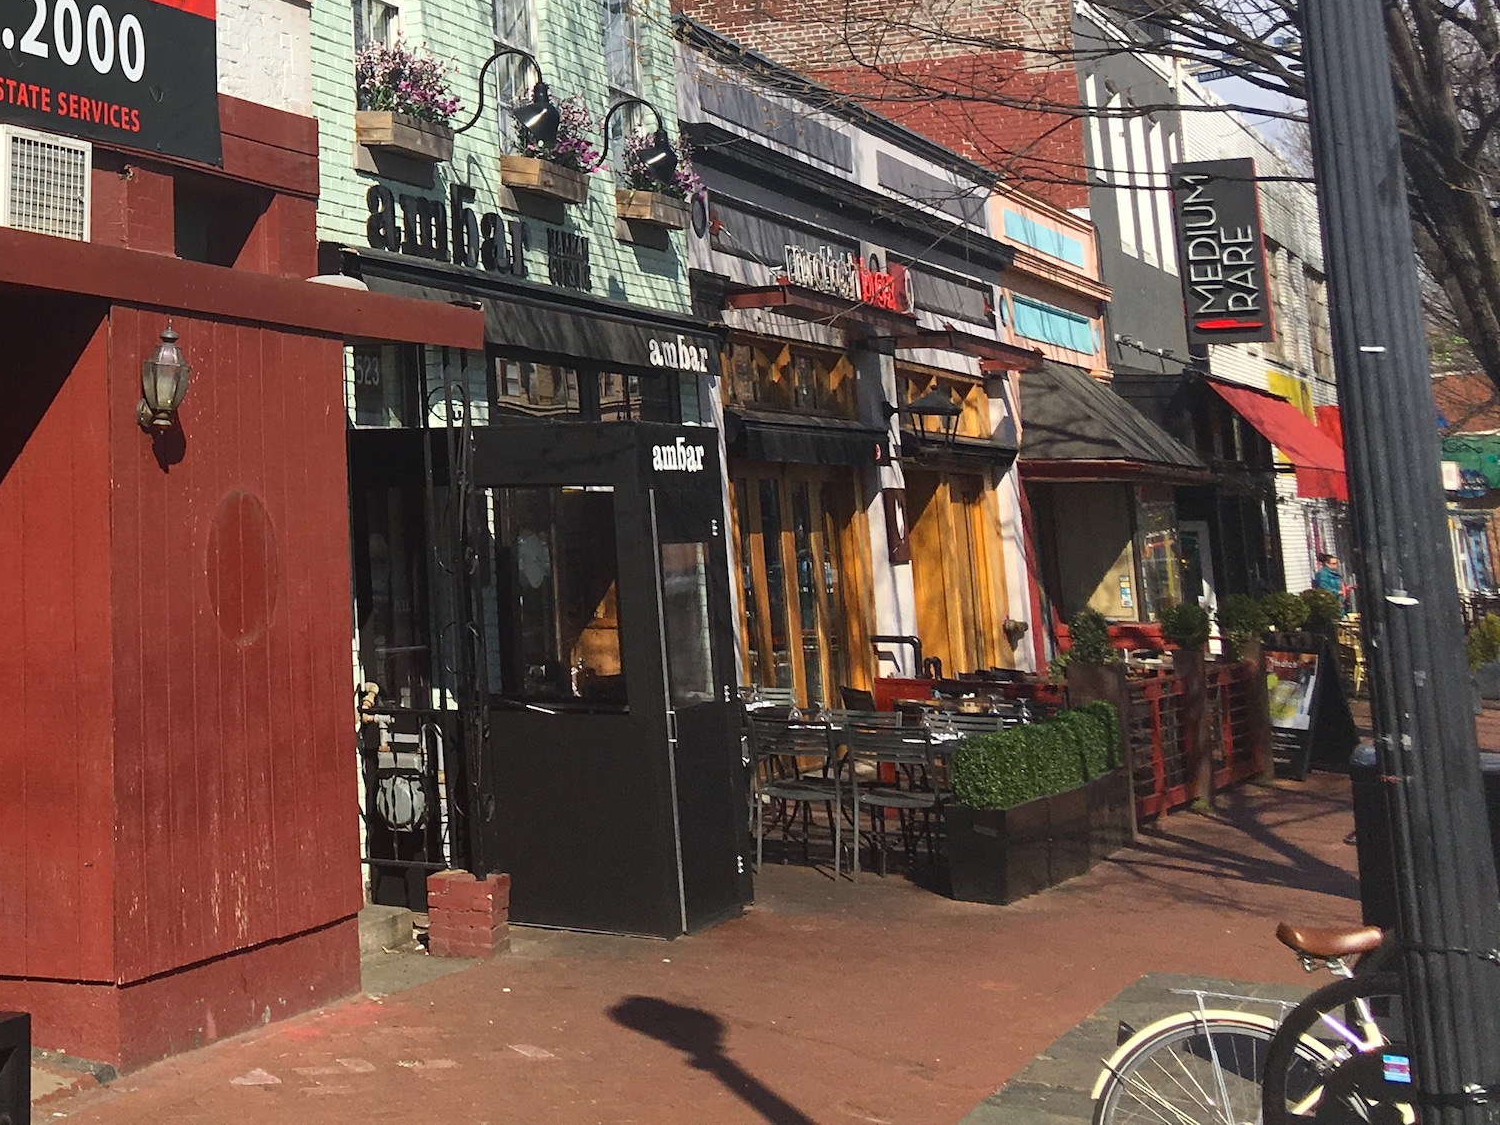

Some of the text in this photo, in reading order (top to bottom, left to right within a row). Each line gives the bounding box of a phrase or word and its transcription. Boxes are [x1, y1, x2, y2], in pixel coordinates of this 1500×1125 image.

[58, 91, 140, 132] SERVICES
[367, 183, 529, 277] ambar
[1181, 174, 1227, 313] MEDIUM
[1220, 225, 1261, 312] RARE
[356, 356, 380, 385] 523
[648, 335, 708, 372] ambar
[652, 437, 705, 472] ambar
